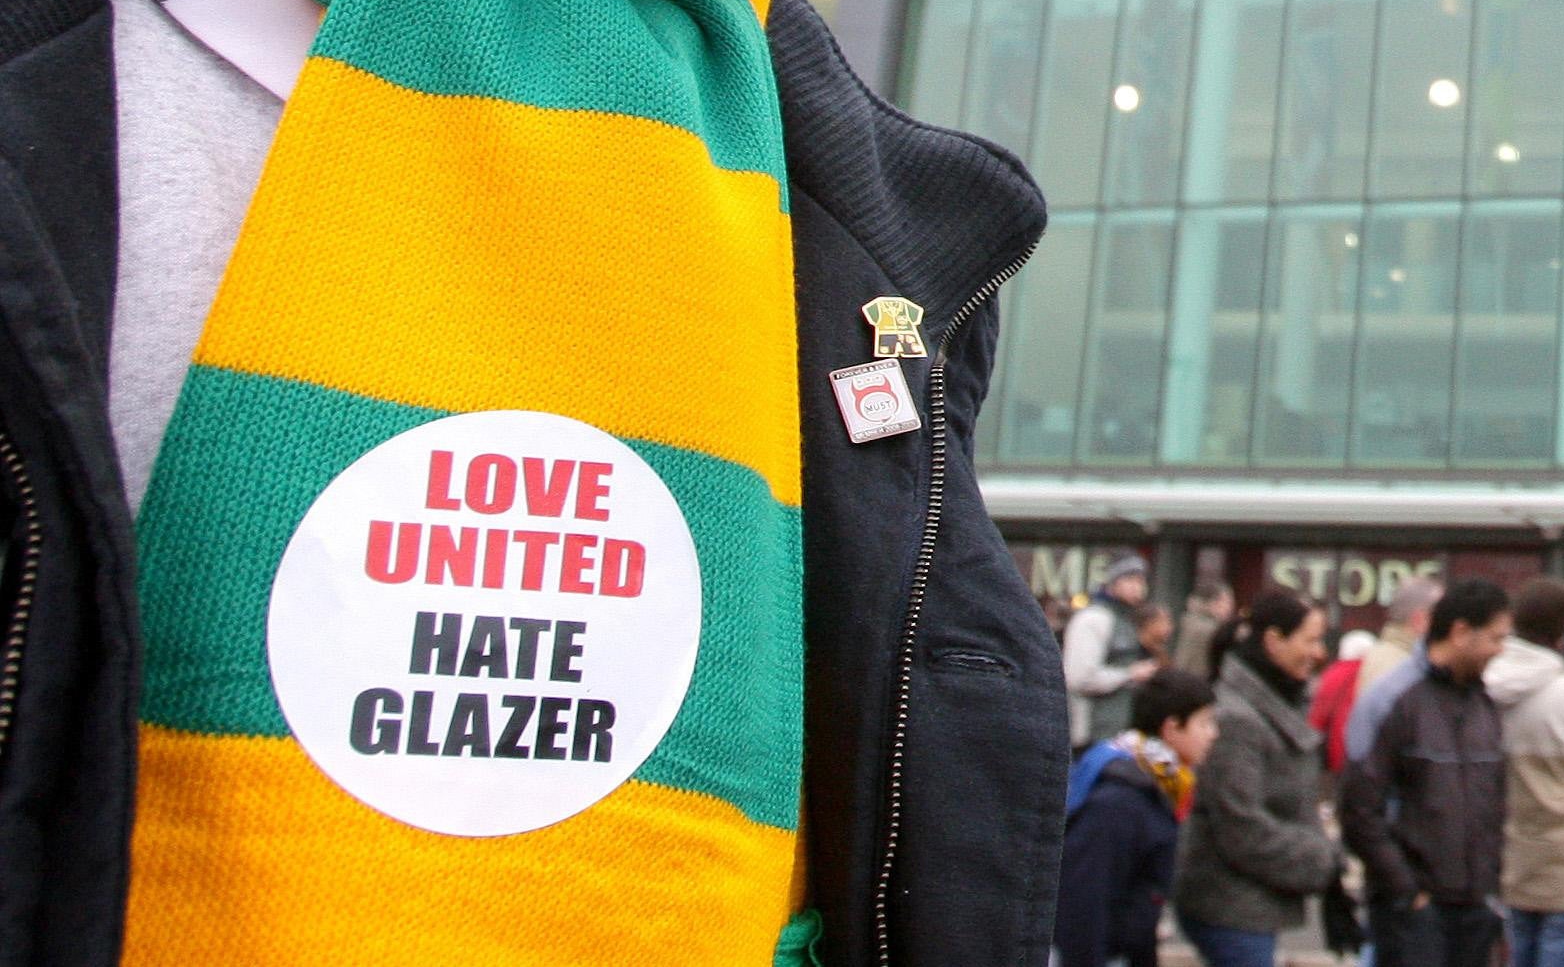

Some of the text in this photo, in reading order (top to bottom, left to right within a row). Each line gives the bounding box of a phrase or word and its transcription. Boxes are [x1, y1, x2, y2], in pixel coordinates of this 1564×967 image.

[424, 450, 614, 523] LOVE
[364, 520, 647, 599] UNITED
[408, 611, 588, 683] HATE
[349, 687, 617, 763] GLAZER
